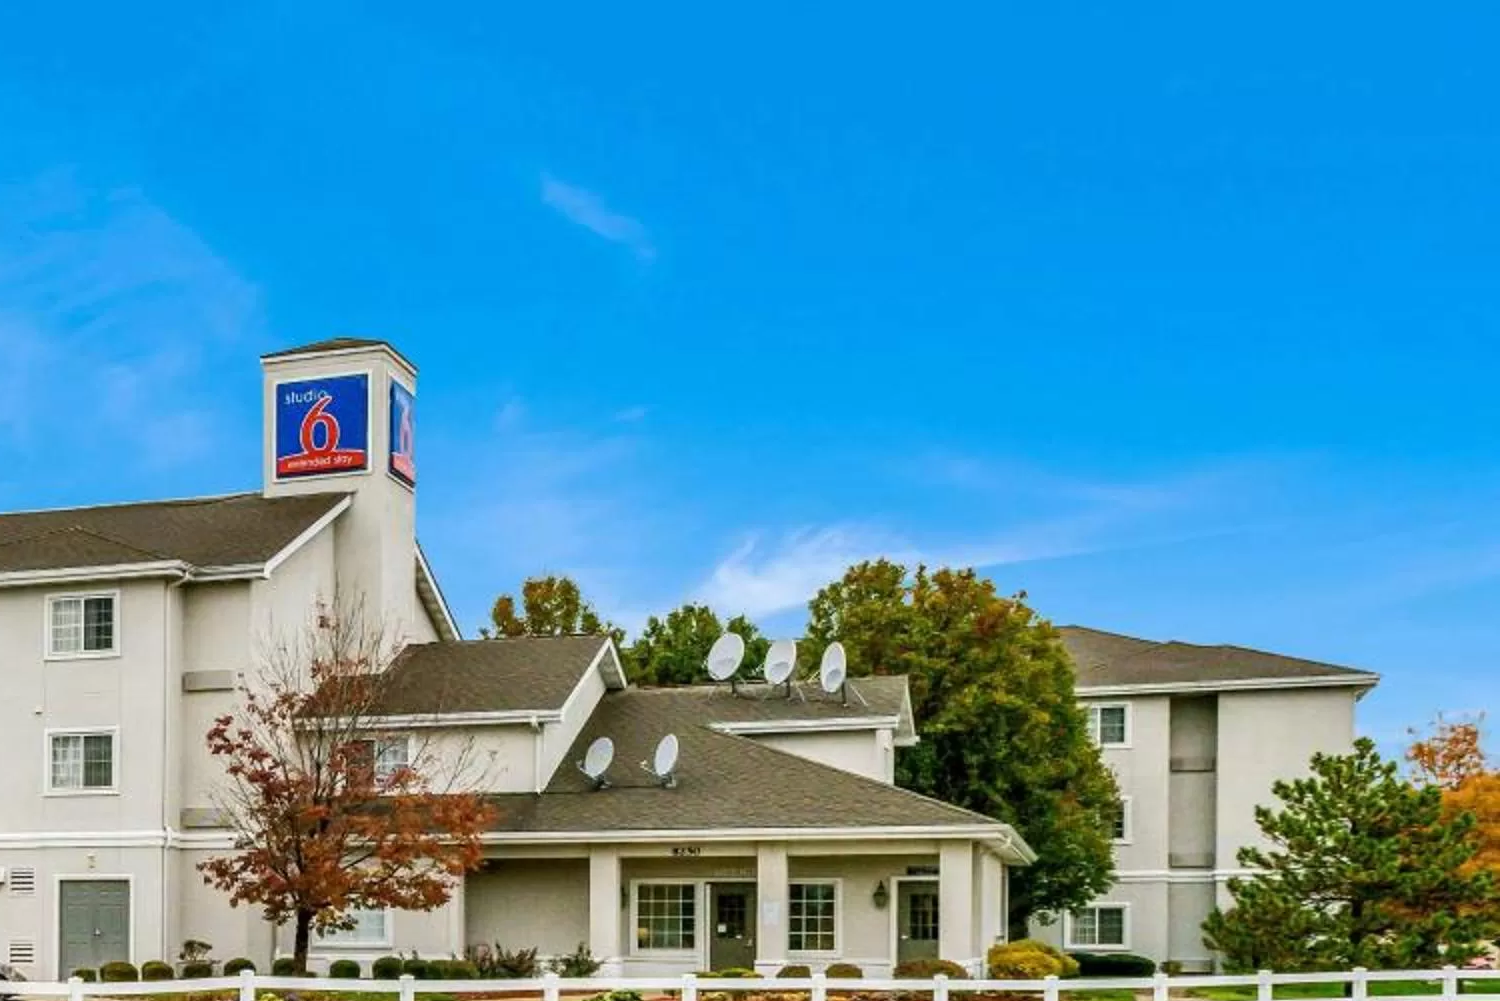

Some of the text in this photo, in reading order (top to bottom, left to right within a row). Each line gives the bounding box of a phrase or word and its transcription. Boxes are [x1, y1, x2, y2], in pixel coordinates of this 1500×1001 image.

[284, 389, 328, 405] studio
[300, 395, 340, 455] 6
[333, 455, 352, 465] stay
